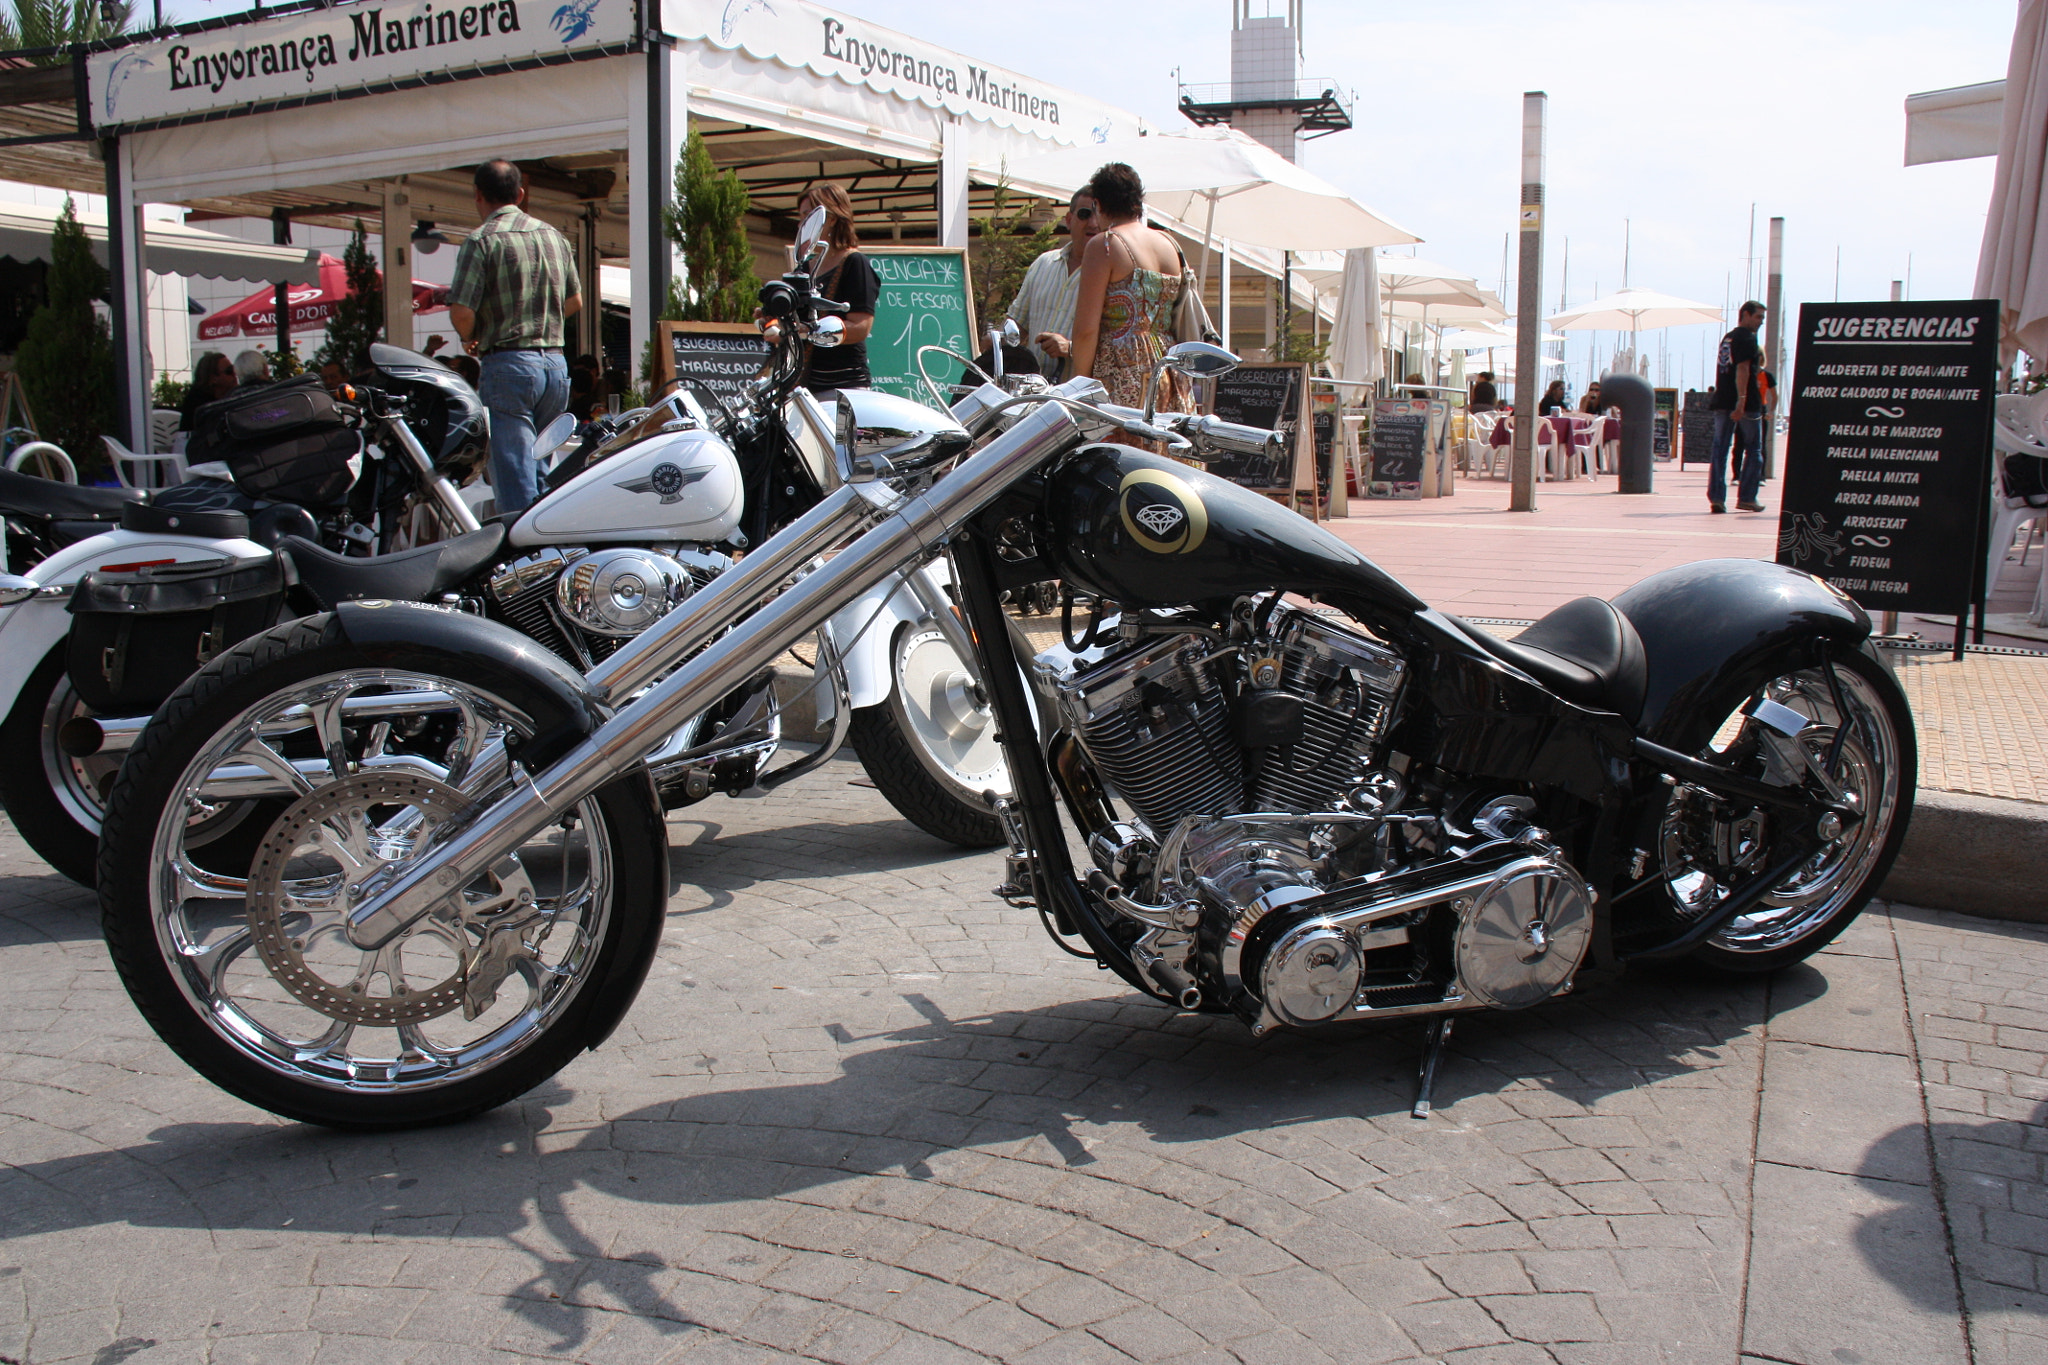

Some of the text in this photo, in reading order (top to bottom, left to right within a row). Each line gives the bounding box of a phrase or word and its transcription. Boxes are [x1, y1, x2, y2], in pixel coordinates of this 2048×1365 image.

[168, 0, 521, 93] Enyorança Marinera
[822, 17, 1060, 126] Enyorança Marinera
[869, 257, 937, 283] RENCIA
[886, 291, 907, 308] DE
[910, 291, 963, 311] PESCADO
[1813, 317, 1980, 339] SUGERENCIAS
[1817, 364, 1969, 377] CALDERETA DE BOGAVANTE
[1802, 386, 1838, 398] ARROZ
[1840, 387, 1890, 399] CALDOSO
[1892, 387, 1908, 399] DE
[1829, 424, 1943, 438] PAELLA DE MARISCO
[1826, 447, 1940, 462] PAELLA VALENCIANA
[1840, 470, 1921, 484] PAELLA MIXTA
[1834, 492, 1920, 507] ARROZ ABANDA
[1843, 515, 1908, 530] ARROSEXAT
[1849, 555, 1891, 569] FIDEUA
[1828, 576, 1910, 594] FIDEUA NEGRA
